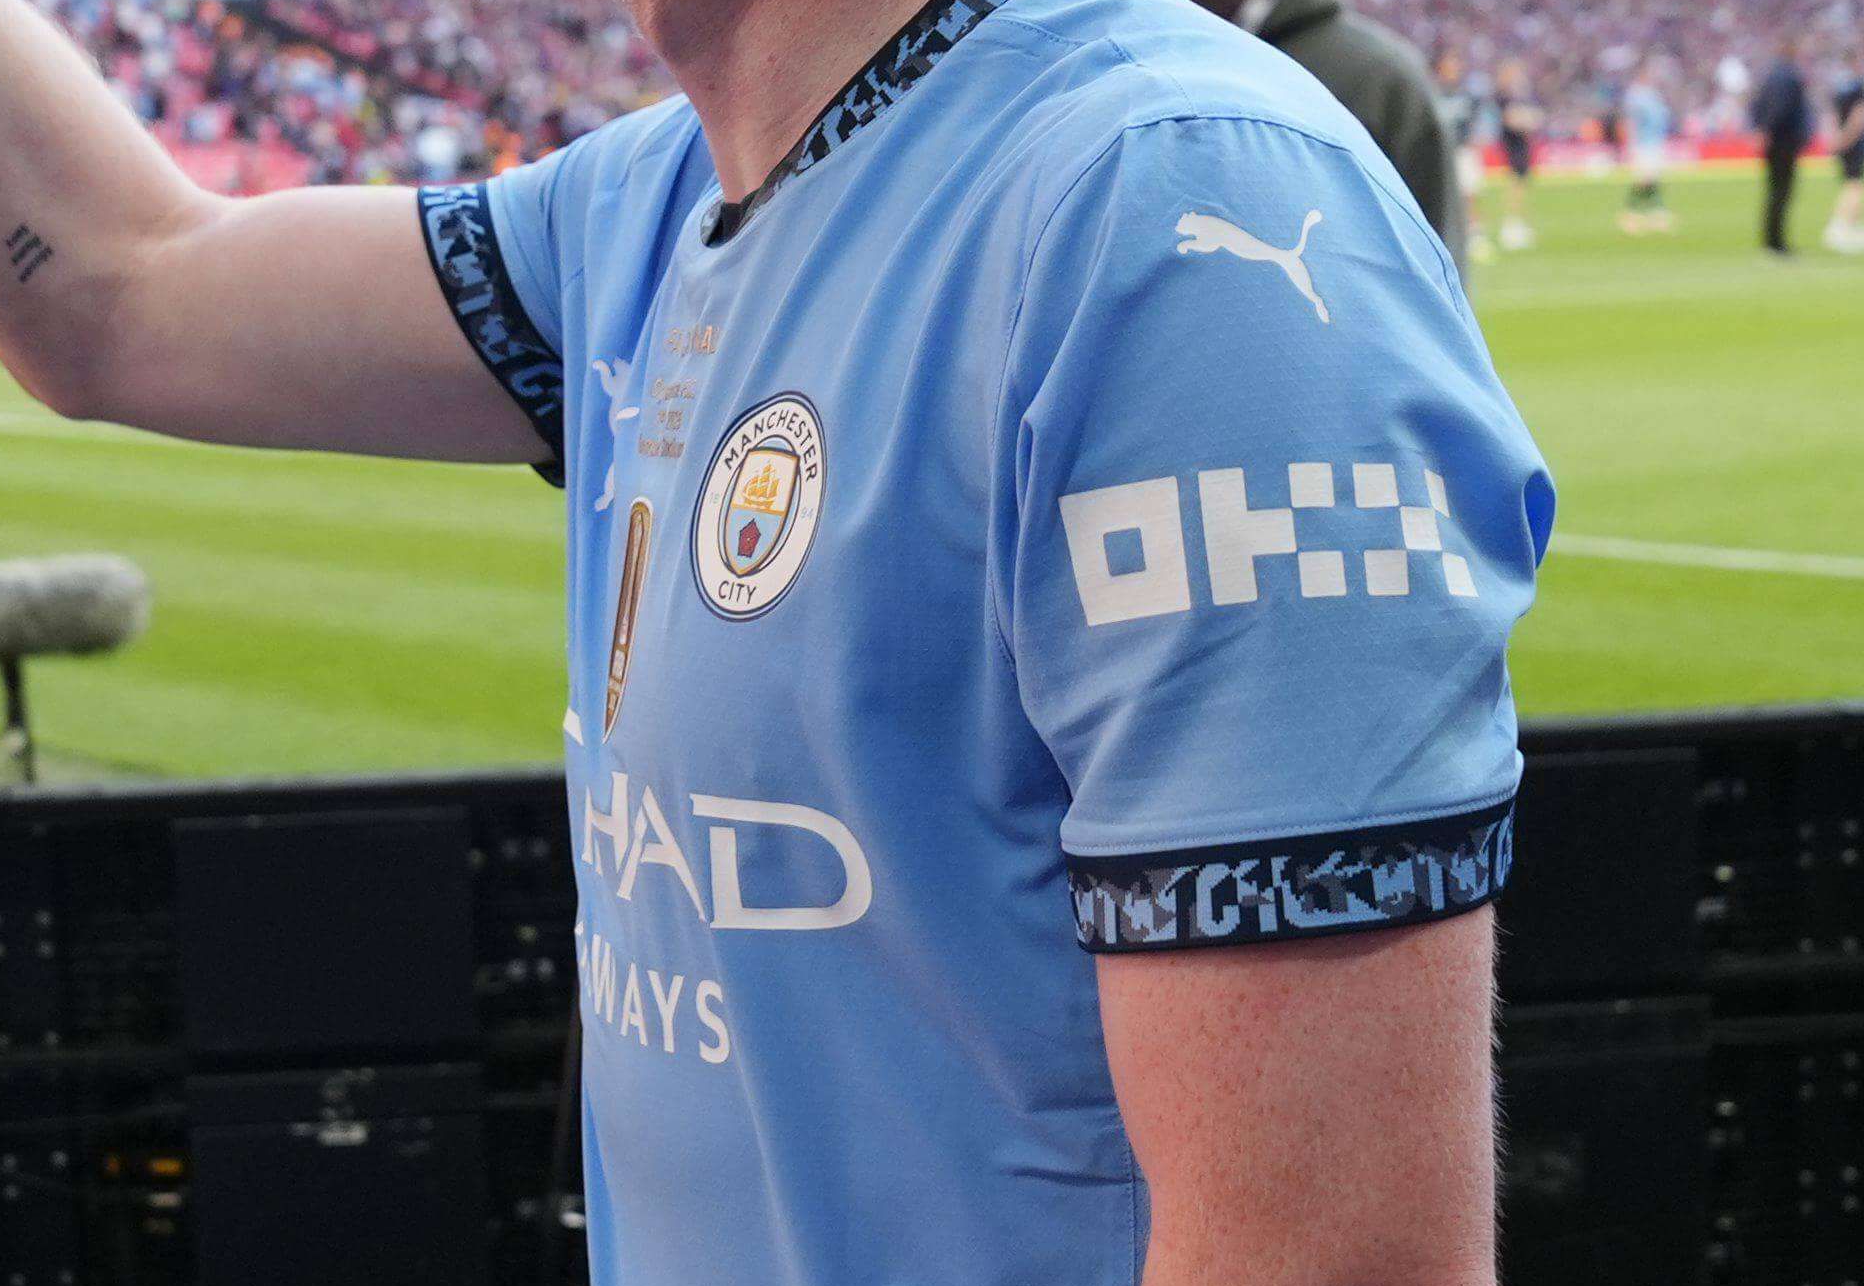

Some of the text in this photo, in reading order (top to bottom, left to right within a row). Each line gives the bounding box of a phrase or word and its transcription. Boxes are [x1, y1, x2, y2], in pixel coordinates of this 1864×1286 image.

[724, 409, 818, 482] MANCHESTER
[718, 580, 756, 604] CITY
[575, 922, 732, 1064] WAYS
